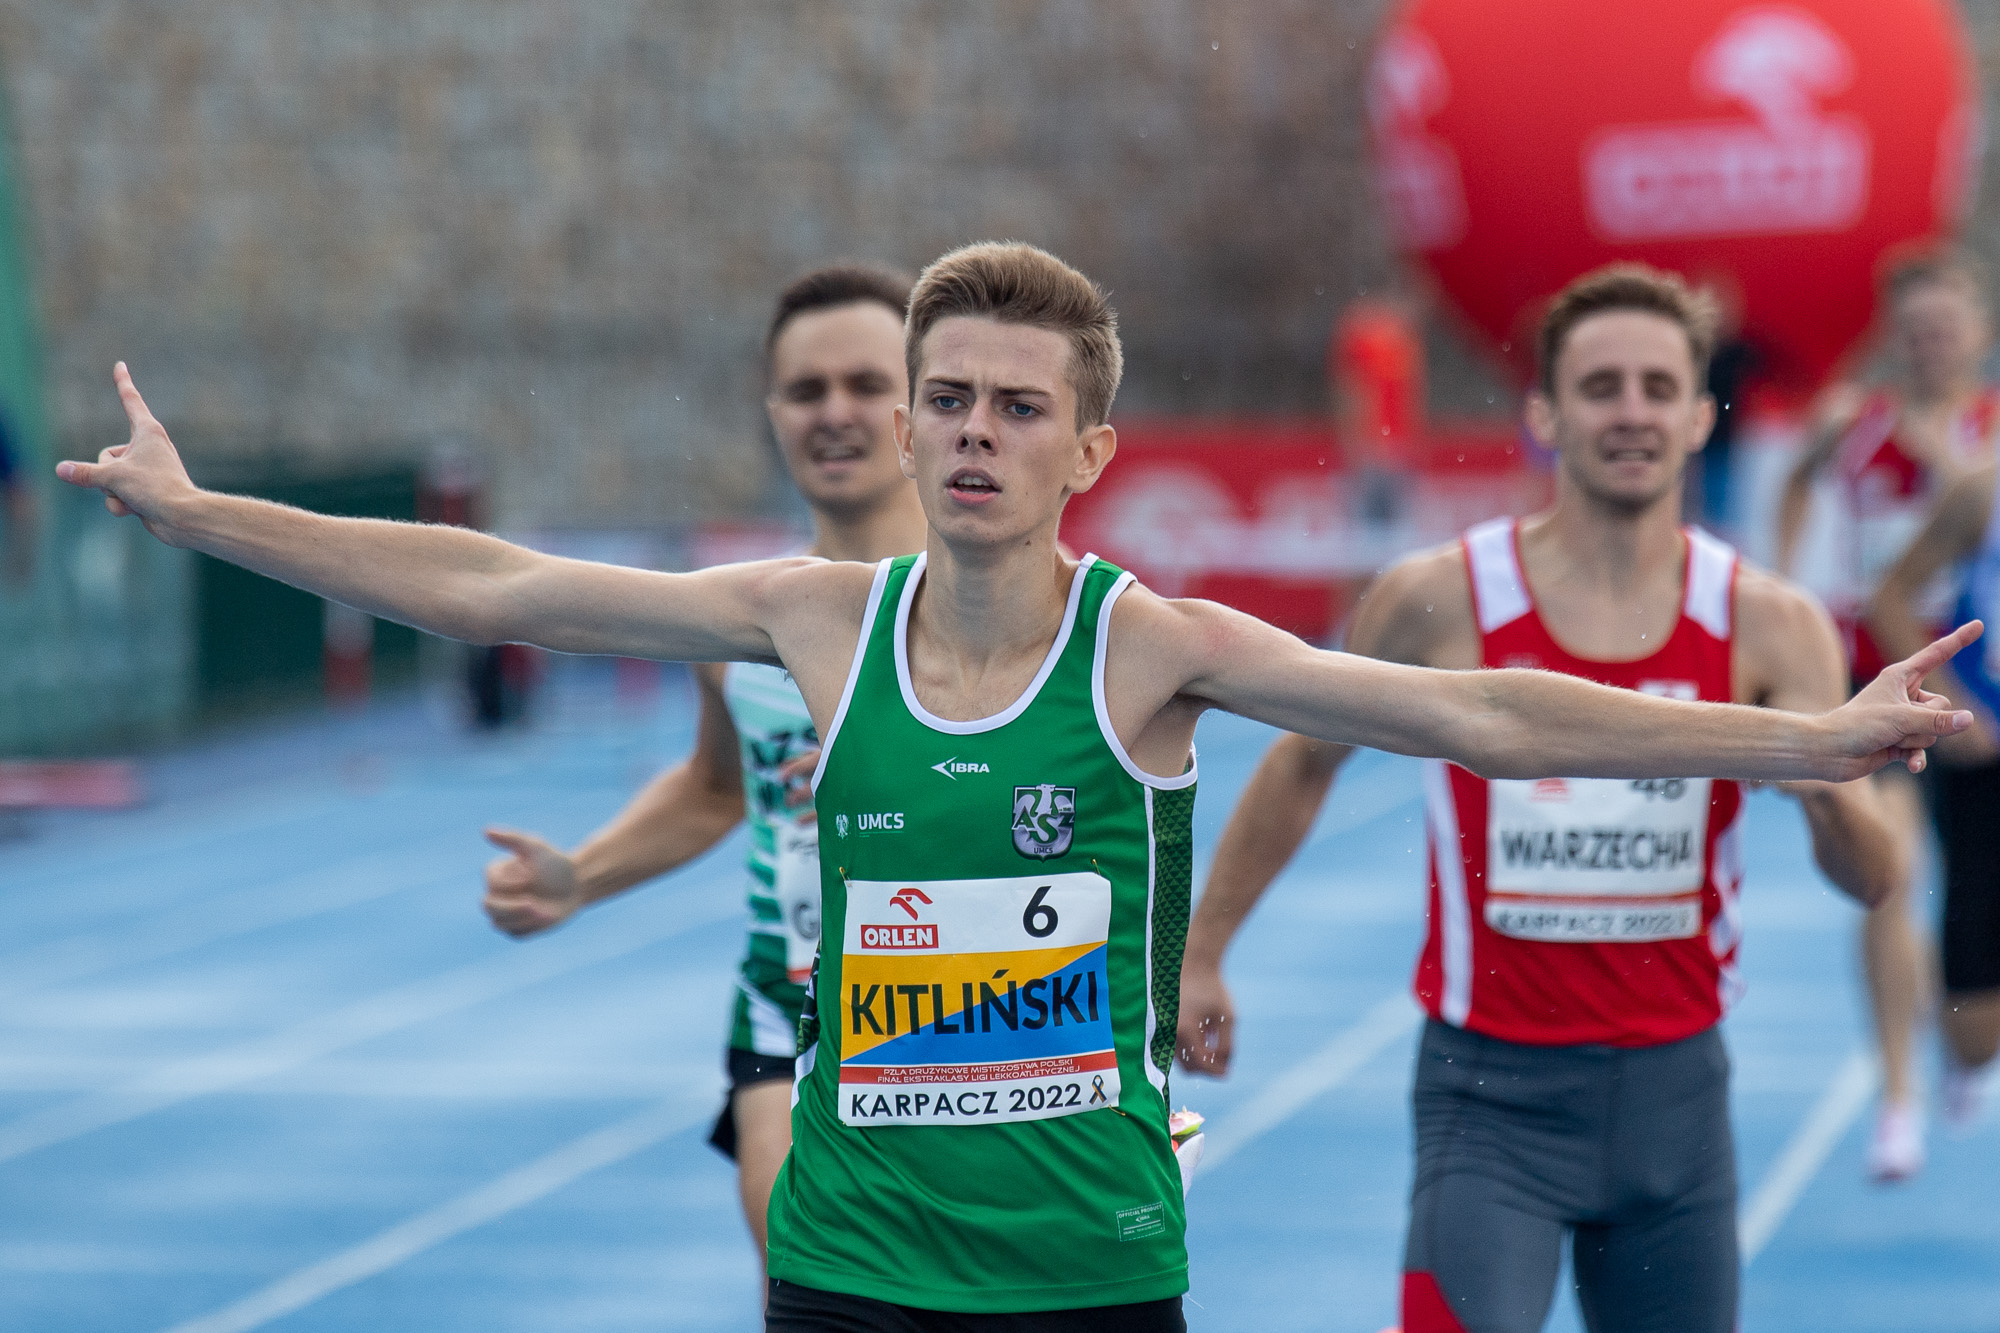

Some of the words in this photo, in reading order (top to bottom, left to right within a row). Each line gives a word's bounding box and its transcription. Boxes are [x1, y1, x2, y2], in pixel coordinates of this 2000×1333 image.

[950, 763, 990, 773] IBRA
[857, 812, 905, 831] UMCS
[1501, 828, 1692, 871] WARZECHA
[1022, 885, 1059, 938] 6
[863, 927, 934, 947] ORLEN
[851, 969, 1100, 1036] KITLIŃSKI
[883, 1068, 907, 1076] PZLA
[970, 1062, 1038, 1074] MISTRZOSTWA
[1040, 1058, 1073, 1068] POLSKI
[903, 1073, 969, 1083] EKSTRAKLASY
[971, 1073, 988, 1082] LIGI
[989, 1065, 1080, 1081] LEKKOATLETYCZNEJ
[851, 1091, 999, 1118] KARPACZ
[1008, 1083, 1082, 1113] 2022
